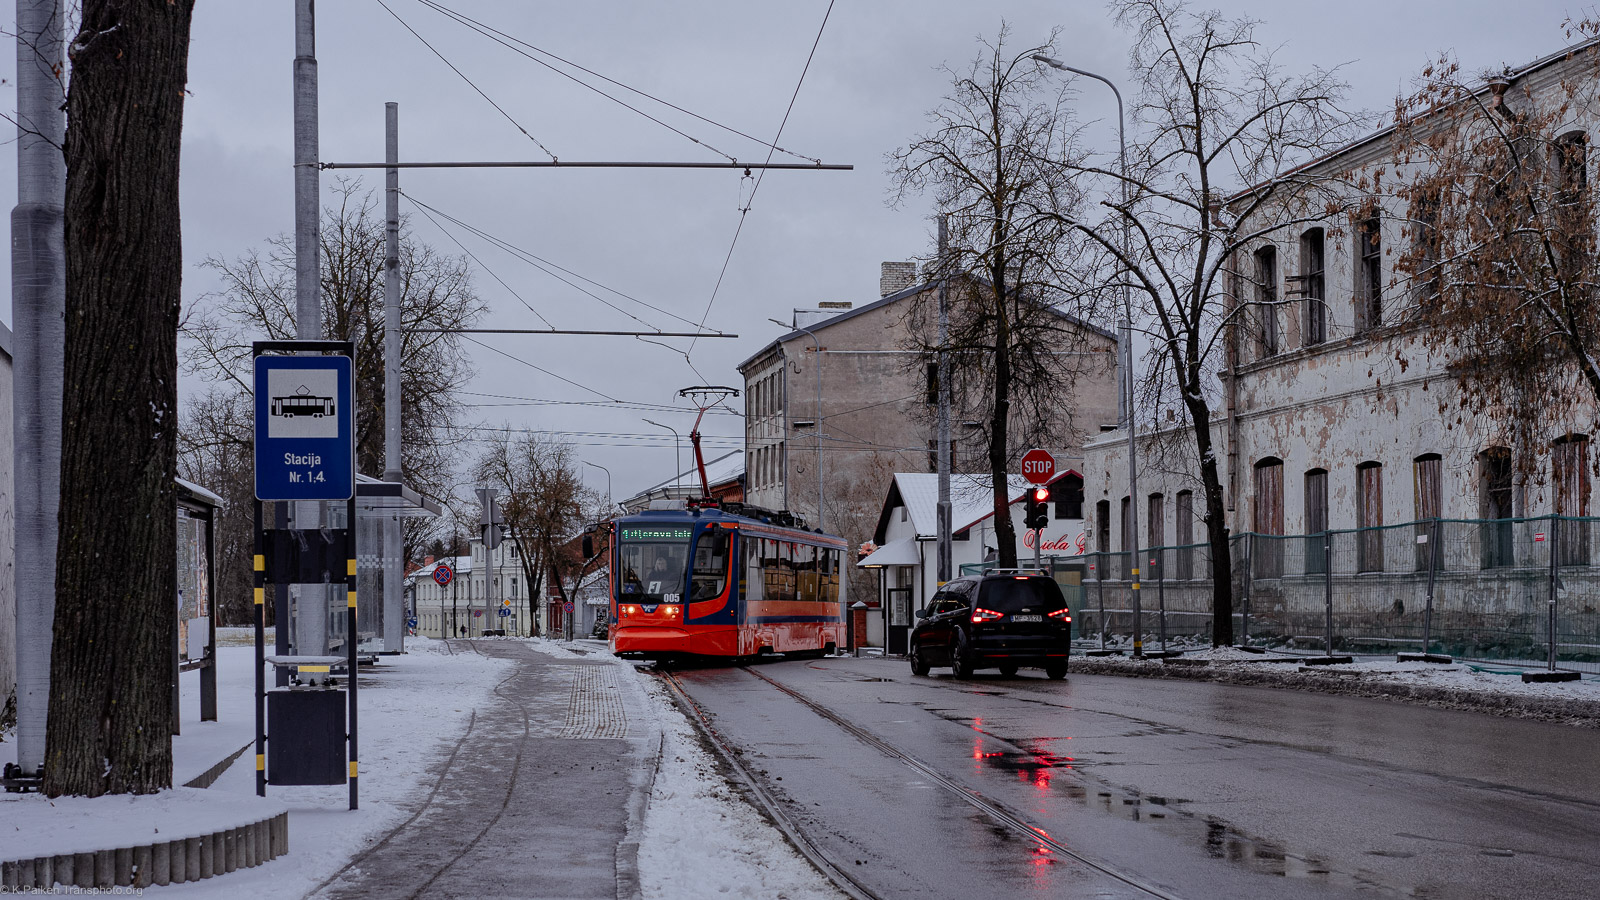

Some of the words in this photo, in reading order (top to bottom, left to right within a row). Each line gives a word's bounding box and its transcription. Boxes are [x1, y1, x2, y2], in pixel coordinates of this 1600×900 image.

[284, 452, 321, 468] Stacija
[1024, 460, 1052, 473] STOP
[289, 471, 304, 483] Nr.
[663, 593, 680, 603] 005
